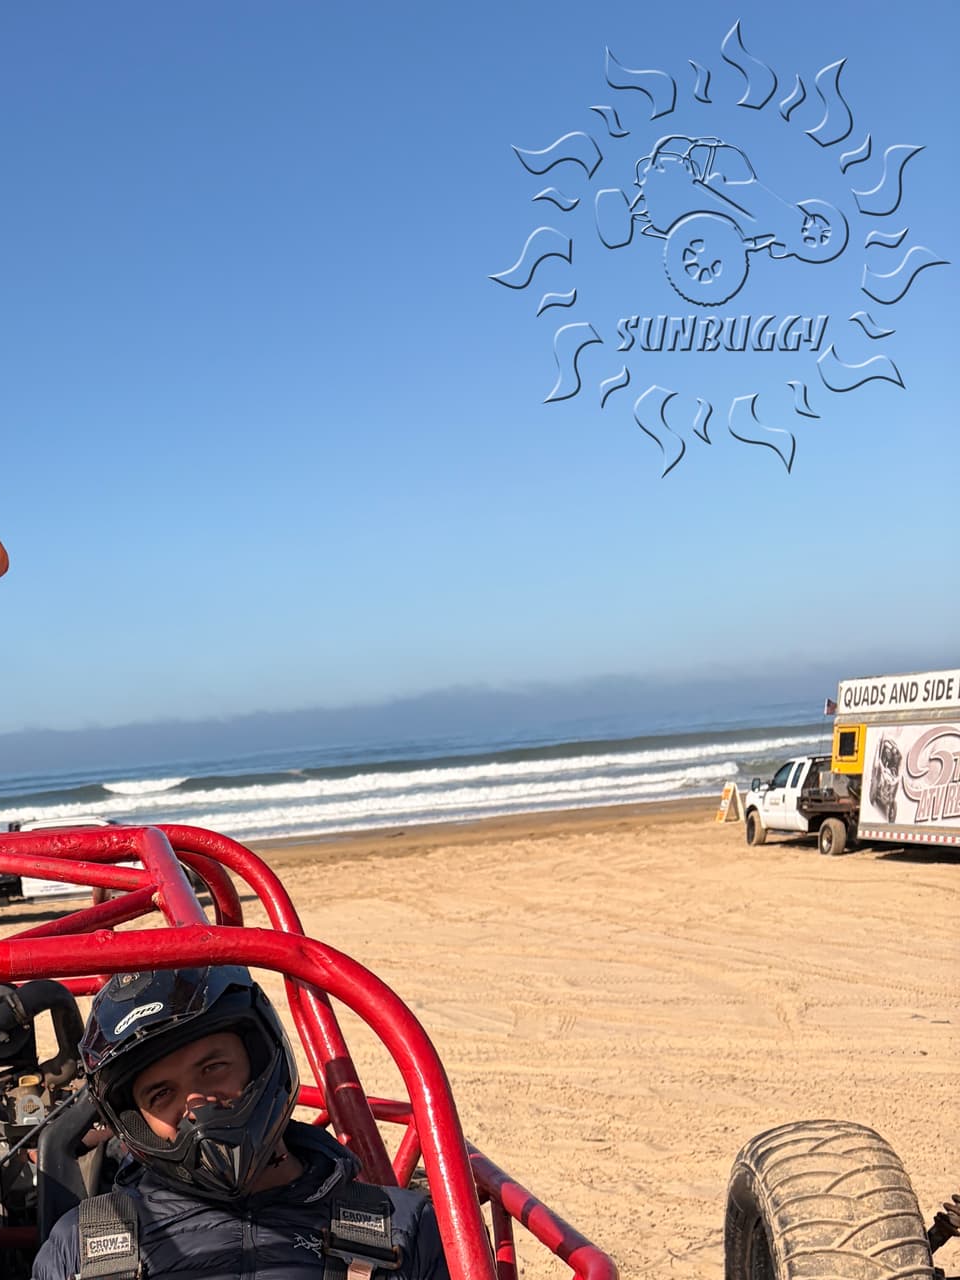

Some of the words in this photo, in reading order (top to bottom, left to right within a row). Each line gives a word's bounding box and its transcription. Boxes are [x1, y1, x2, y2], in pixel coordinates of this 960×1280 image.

[844, 684, 886, 708] QUADS
[889, 682, 919, 704] AND
[922, 678, 954, 701] SIDE
[343, 1210, 371, 1222] CROW
[89, 1237, 118, 1250] CROW
